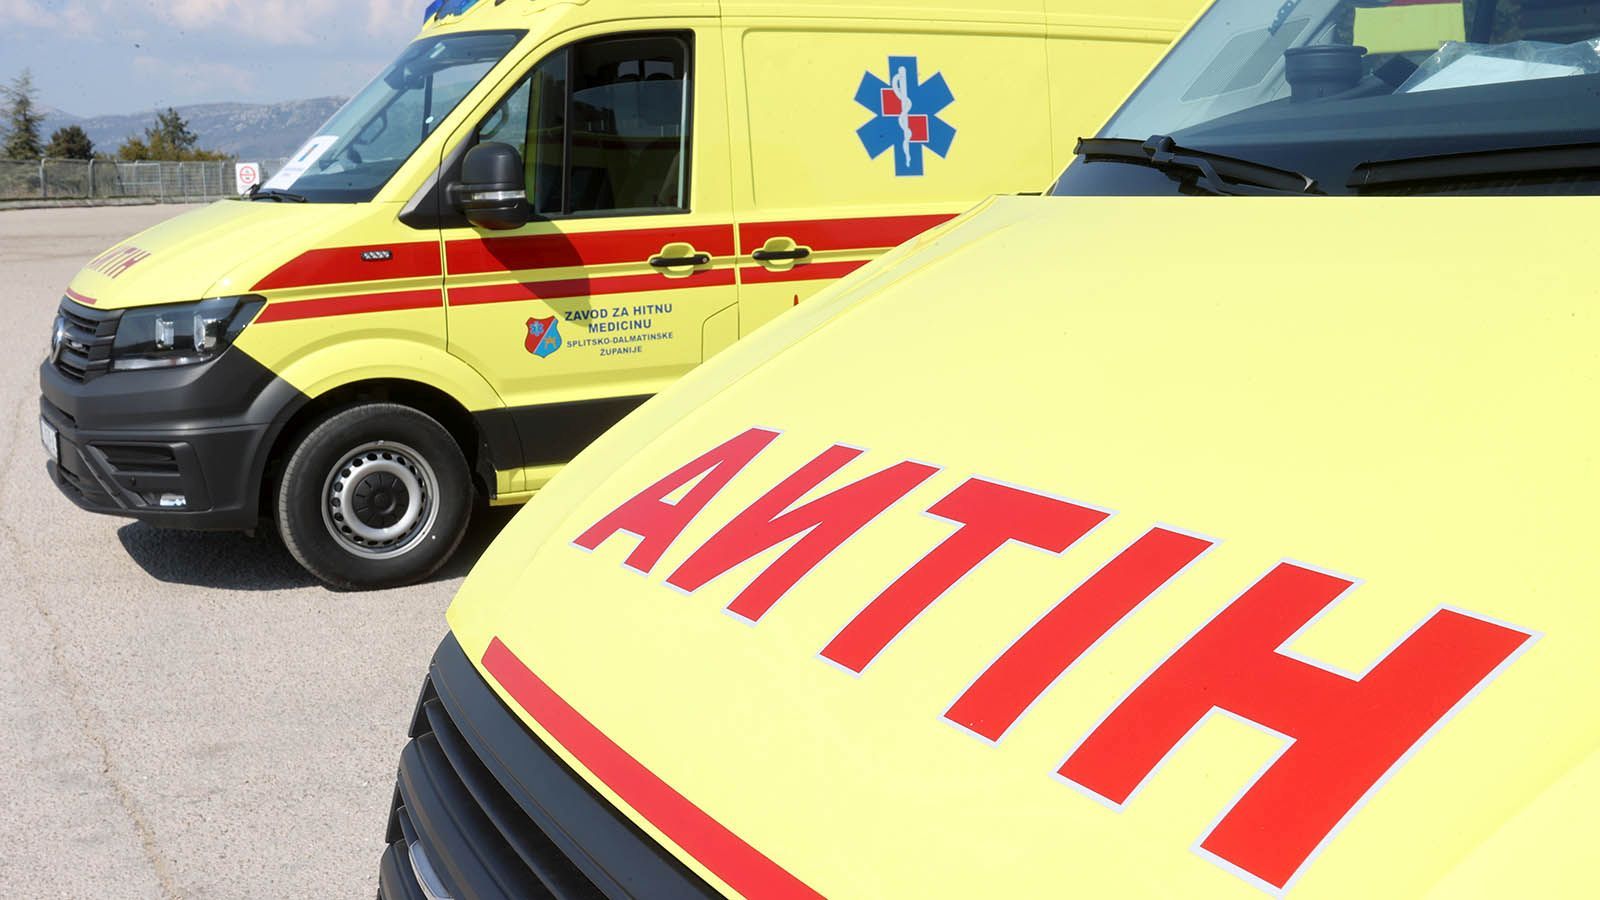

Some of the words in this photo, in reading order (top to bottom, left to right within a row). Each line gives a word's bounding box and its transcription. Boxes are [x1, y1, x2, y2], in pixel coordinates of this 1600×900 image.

[565, 308, 608, 321] ZAVOD
[612, 307, 629, 318] ZA
[633, 303, 673, 316] HITNU
[588, 318, 652, 333] MEDICINU
[566, 332, 673, 348] SPLITSKO-DALMATINSKE
[600, 345, 643, 356] ŽUPANIJE
